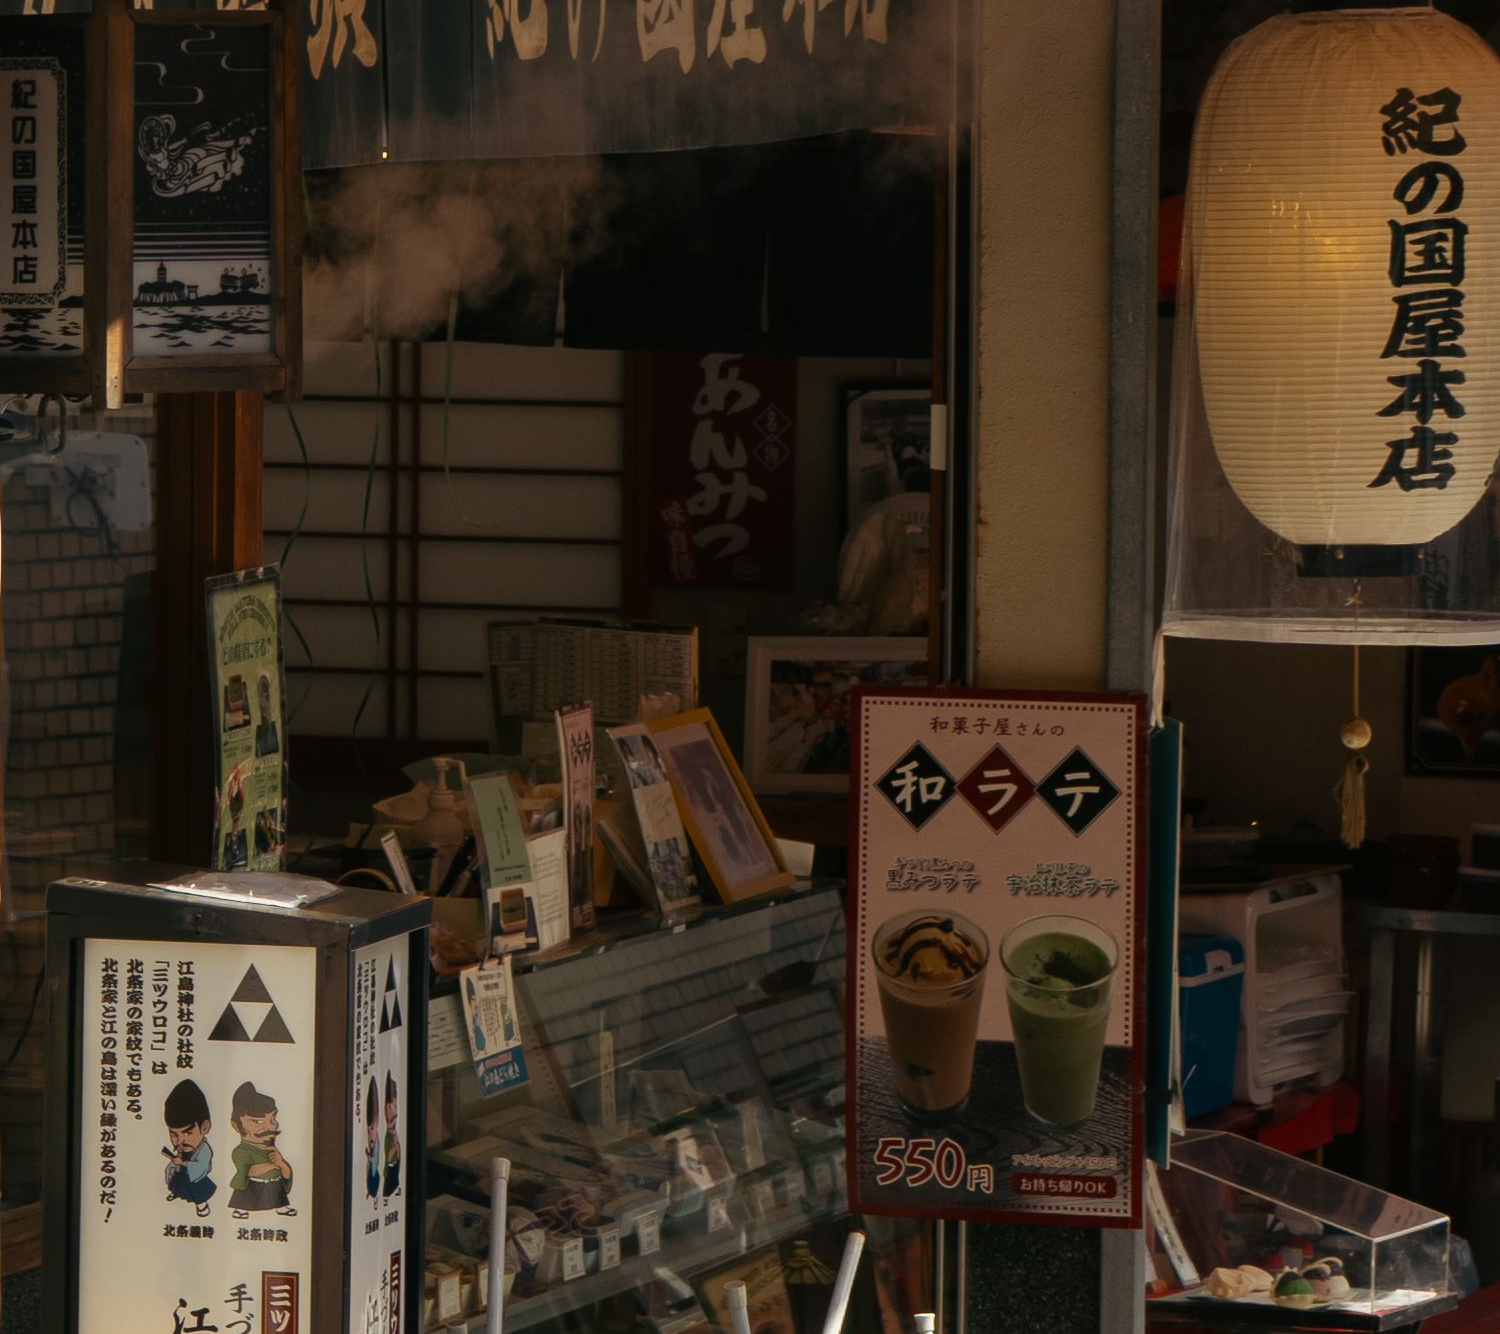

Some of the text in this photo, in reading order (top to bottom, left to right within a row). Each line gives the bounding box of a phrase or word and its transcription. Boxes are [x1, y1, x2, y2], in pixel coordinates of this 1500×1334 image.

[12, 78, 38, 284] 紀の国屋本店
[1368, 87, 1468, 490] 紀の国屋本店
[686, 352, 768, 561] あんみつ
[929, 716, 1065, 737] 和菓子屋さんの
[886, 869, 980, 892] 黒みつラテ
[1006, 874, 1120, 897] 宇治抹茶ラテ
[126, 958, 144, 1121] 北条家の家紋でもある。
[176, 960, 194, 1069] 江島神社の社紋
[873, 1137, 994, 1194] 550円
[236, 1226, 288, 1243] 北条時政
